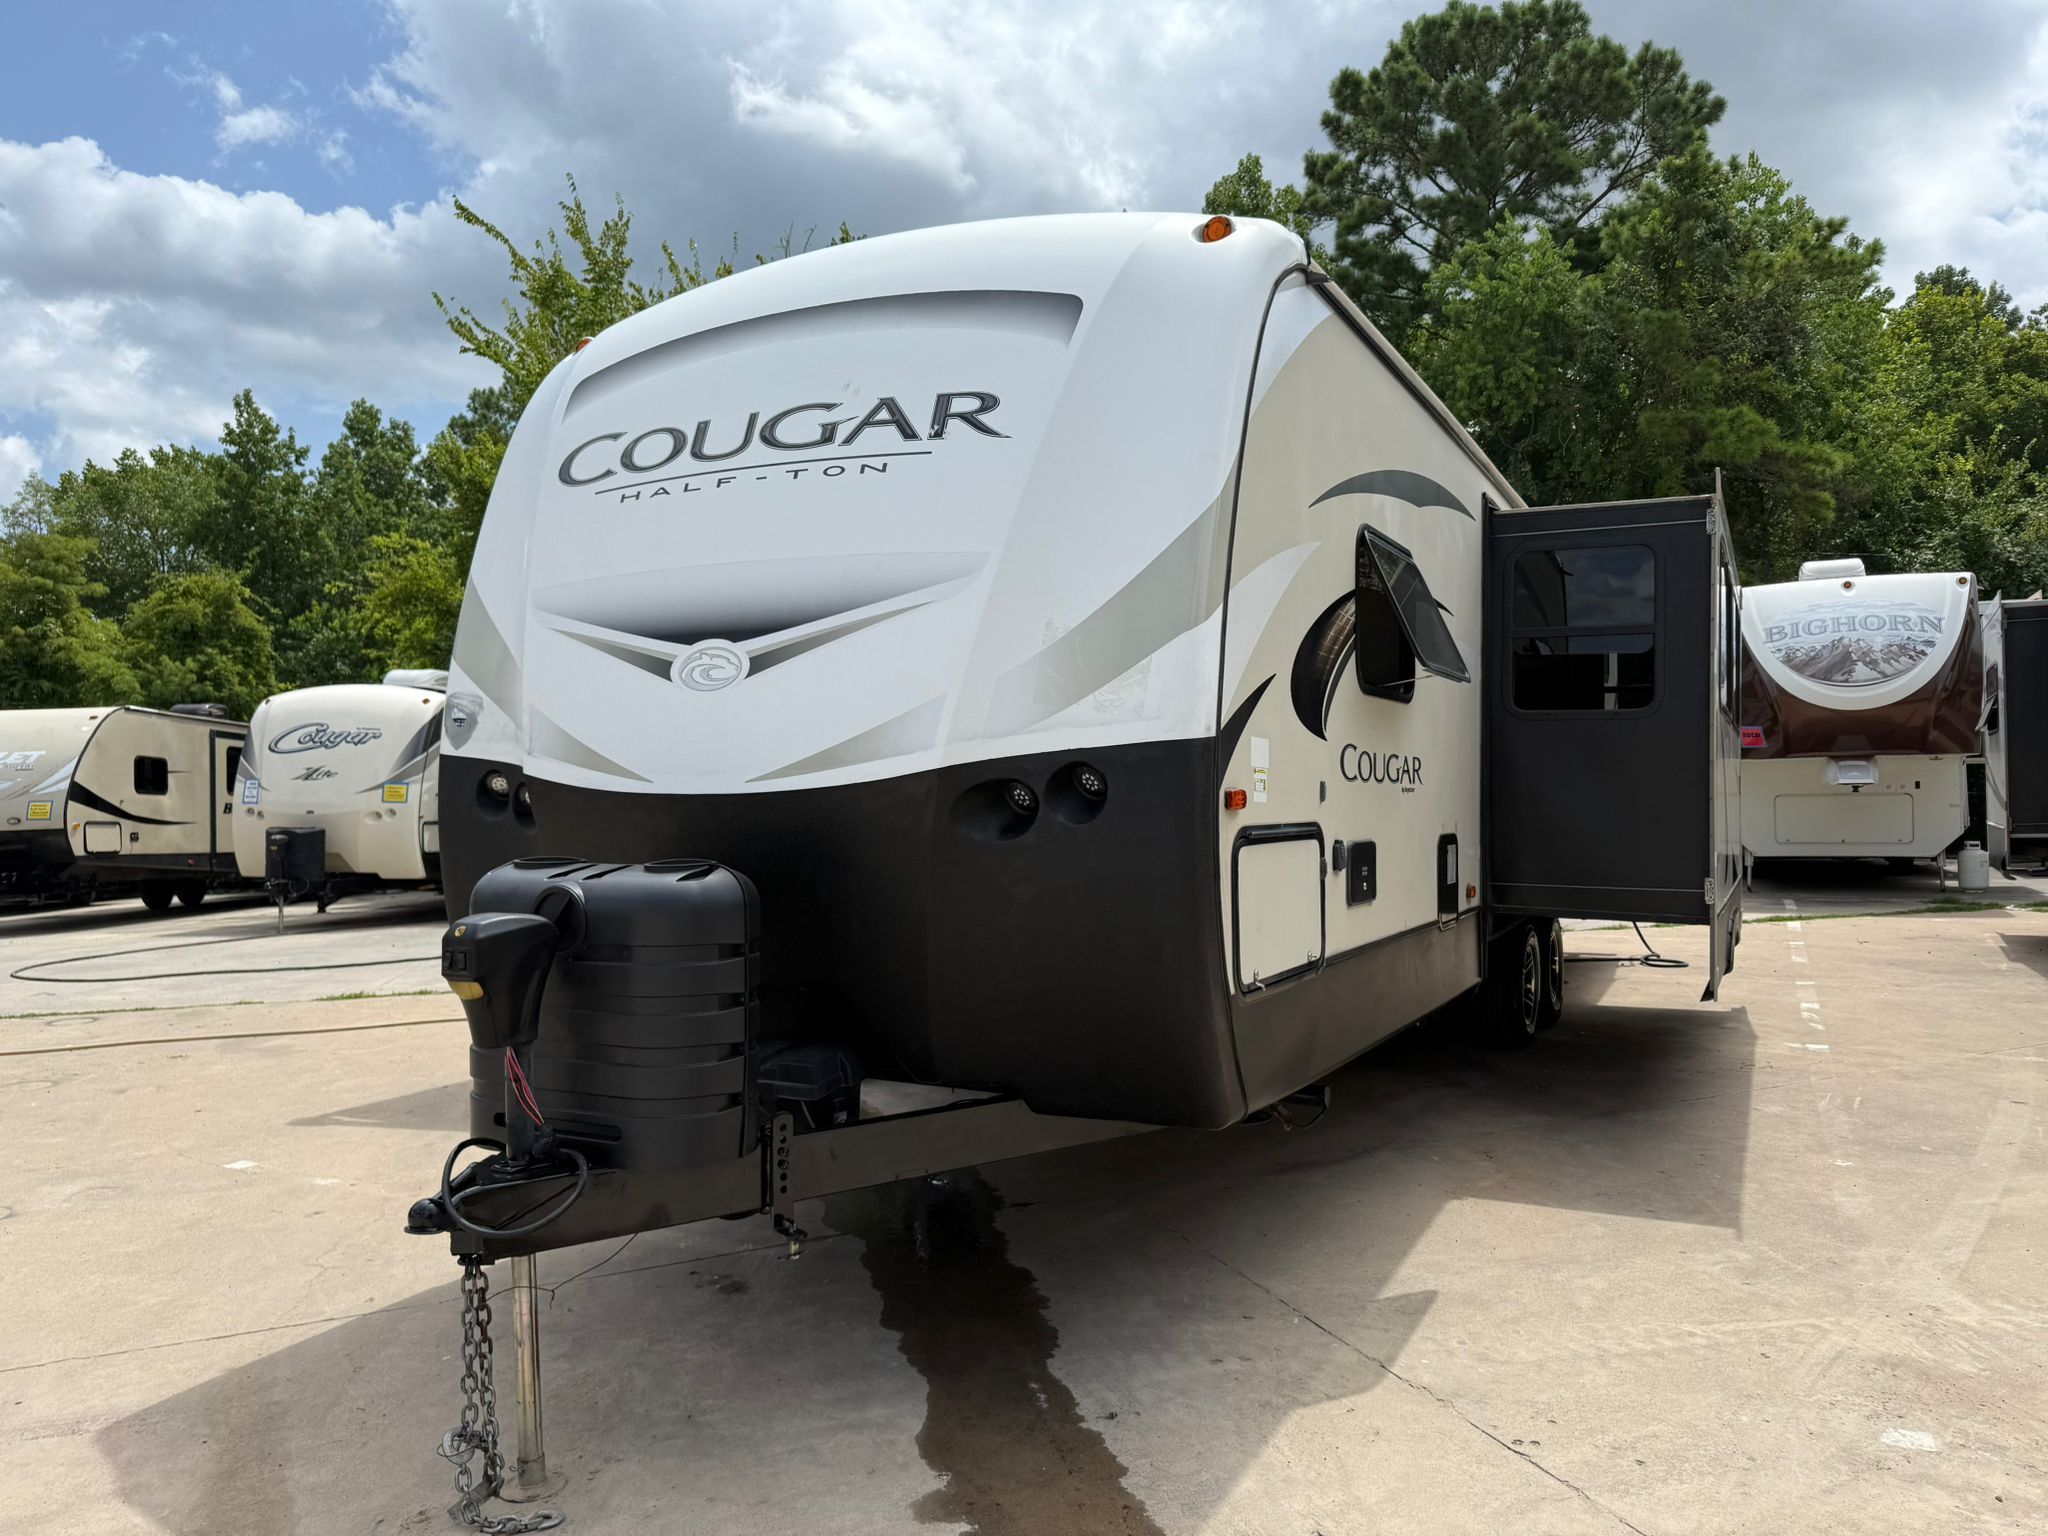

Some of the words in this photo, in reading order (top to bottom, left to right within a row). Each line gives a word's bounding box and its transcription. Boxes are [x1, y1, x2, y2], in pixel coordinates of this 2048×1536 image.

[558, 390, 1012, 488] COUGAR
[1763, 614, 1945, 644] BIGHORN
[268, 722, 382, 754] Cougar
[1340, 743, 1424, 785] COUGAR
